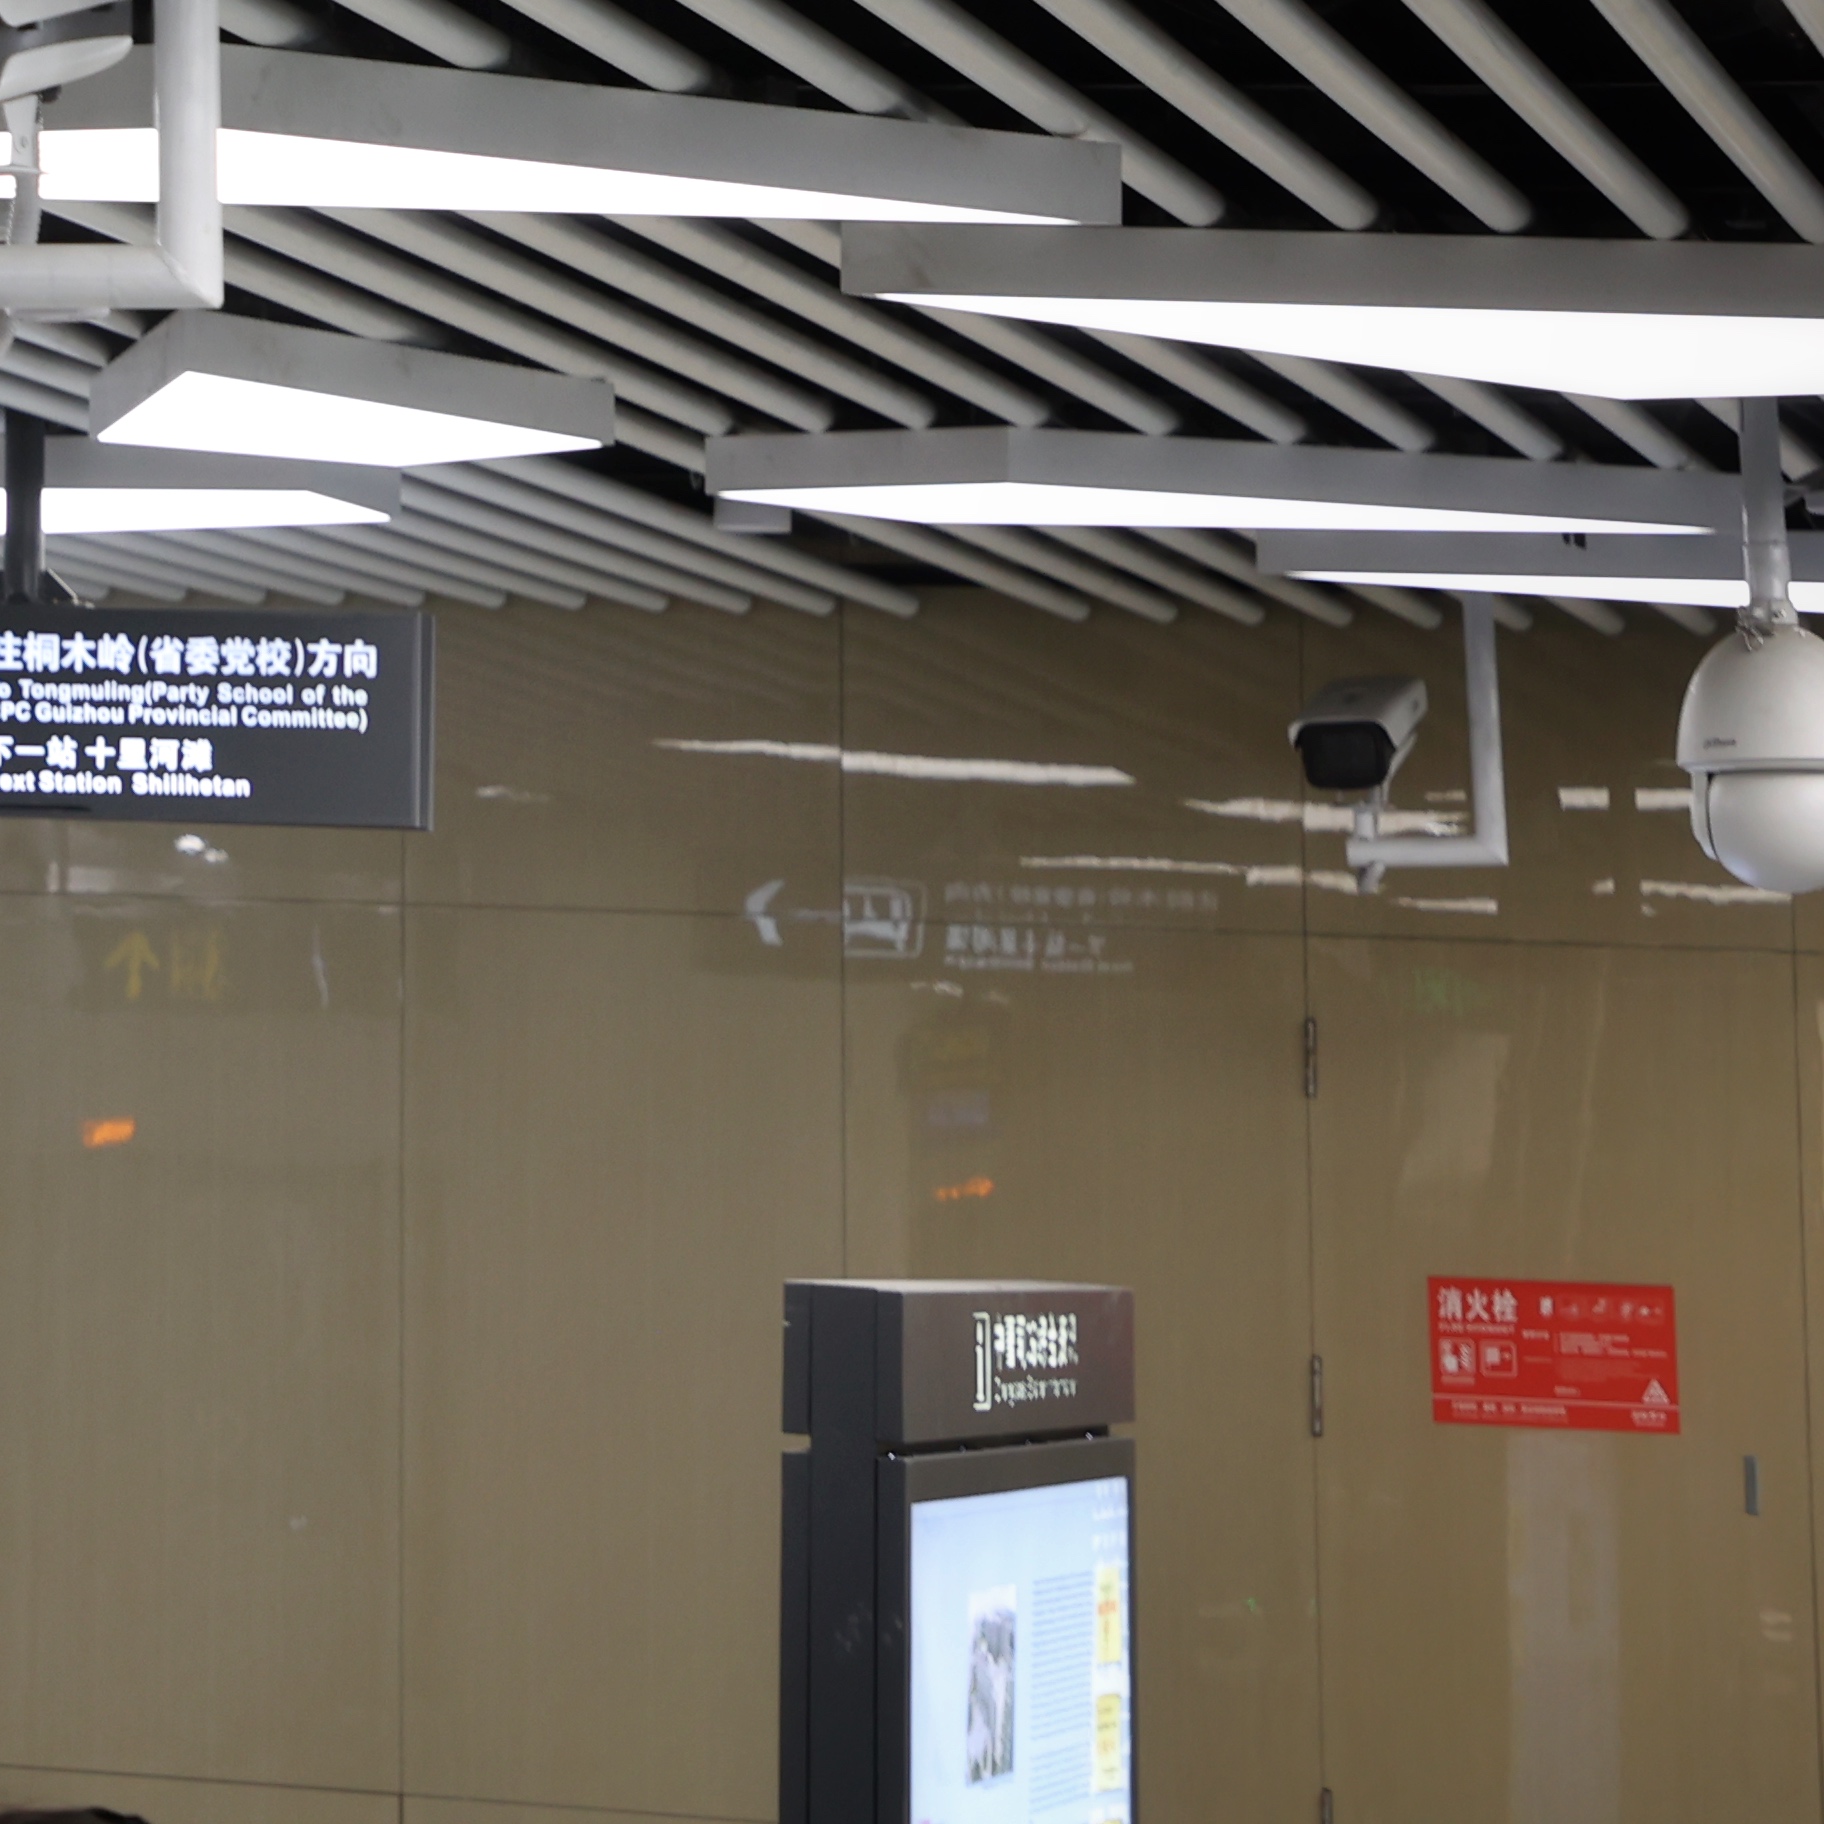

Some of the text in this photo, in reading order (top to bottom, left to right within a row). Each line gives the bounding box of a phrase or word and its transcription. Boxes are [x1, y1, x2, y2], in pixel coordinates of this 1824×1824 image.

[18, 678, 209, 707] Tongmuling(Party
[217, 681, 293, 705] School
[301, 683, 326, 705] of
[332, 684, 368, 706] the
[34, 699, 124, 724] Guizhou
[128, 702, 238, 726] Provincial
[241, 704, 368, 734] Committee)
[84, 735, 212, 772] 十里河滩
[38, 768, 122, 794] Station
[132, 771, 251, 798] Shilihetan
[1437, 1285, 1518, 1323] 消火栓
